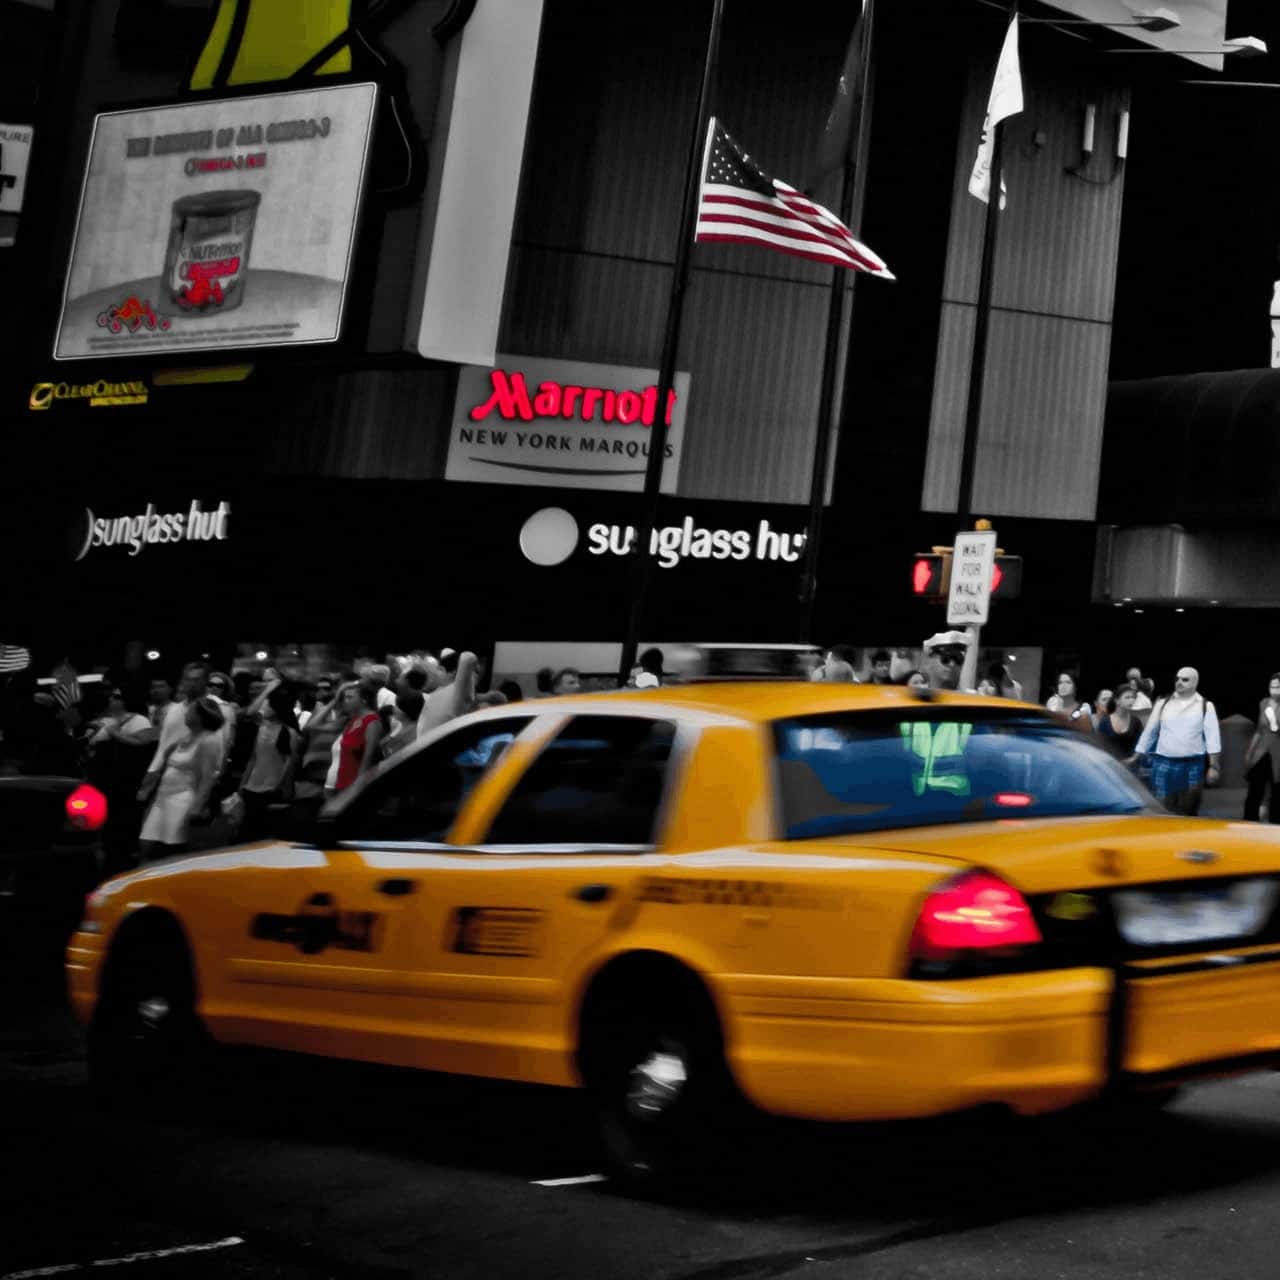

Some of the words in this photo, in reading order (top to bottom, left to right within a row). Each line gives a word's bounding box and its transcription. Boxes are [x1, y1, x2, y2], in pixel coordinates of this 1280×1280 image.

[458, 428, 508, 447] NEW
[516, 432, 571, 452] YORK
[579, 434, 675, 459] MARQUS
[92, 502, 185, 557] sunglass
[186, 498, 231, 541] hut
[962, 543, 986, 558] WAIT
[961, 561, 982, 577] FOR
[955, 583, 984, 597] WALK
